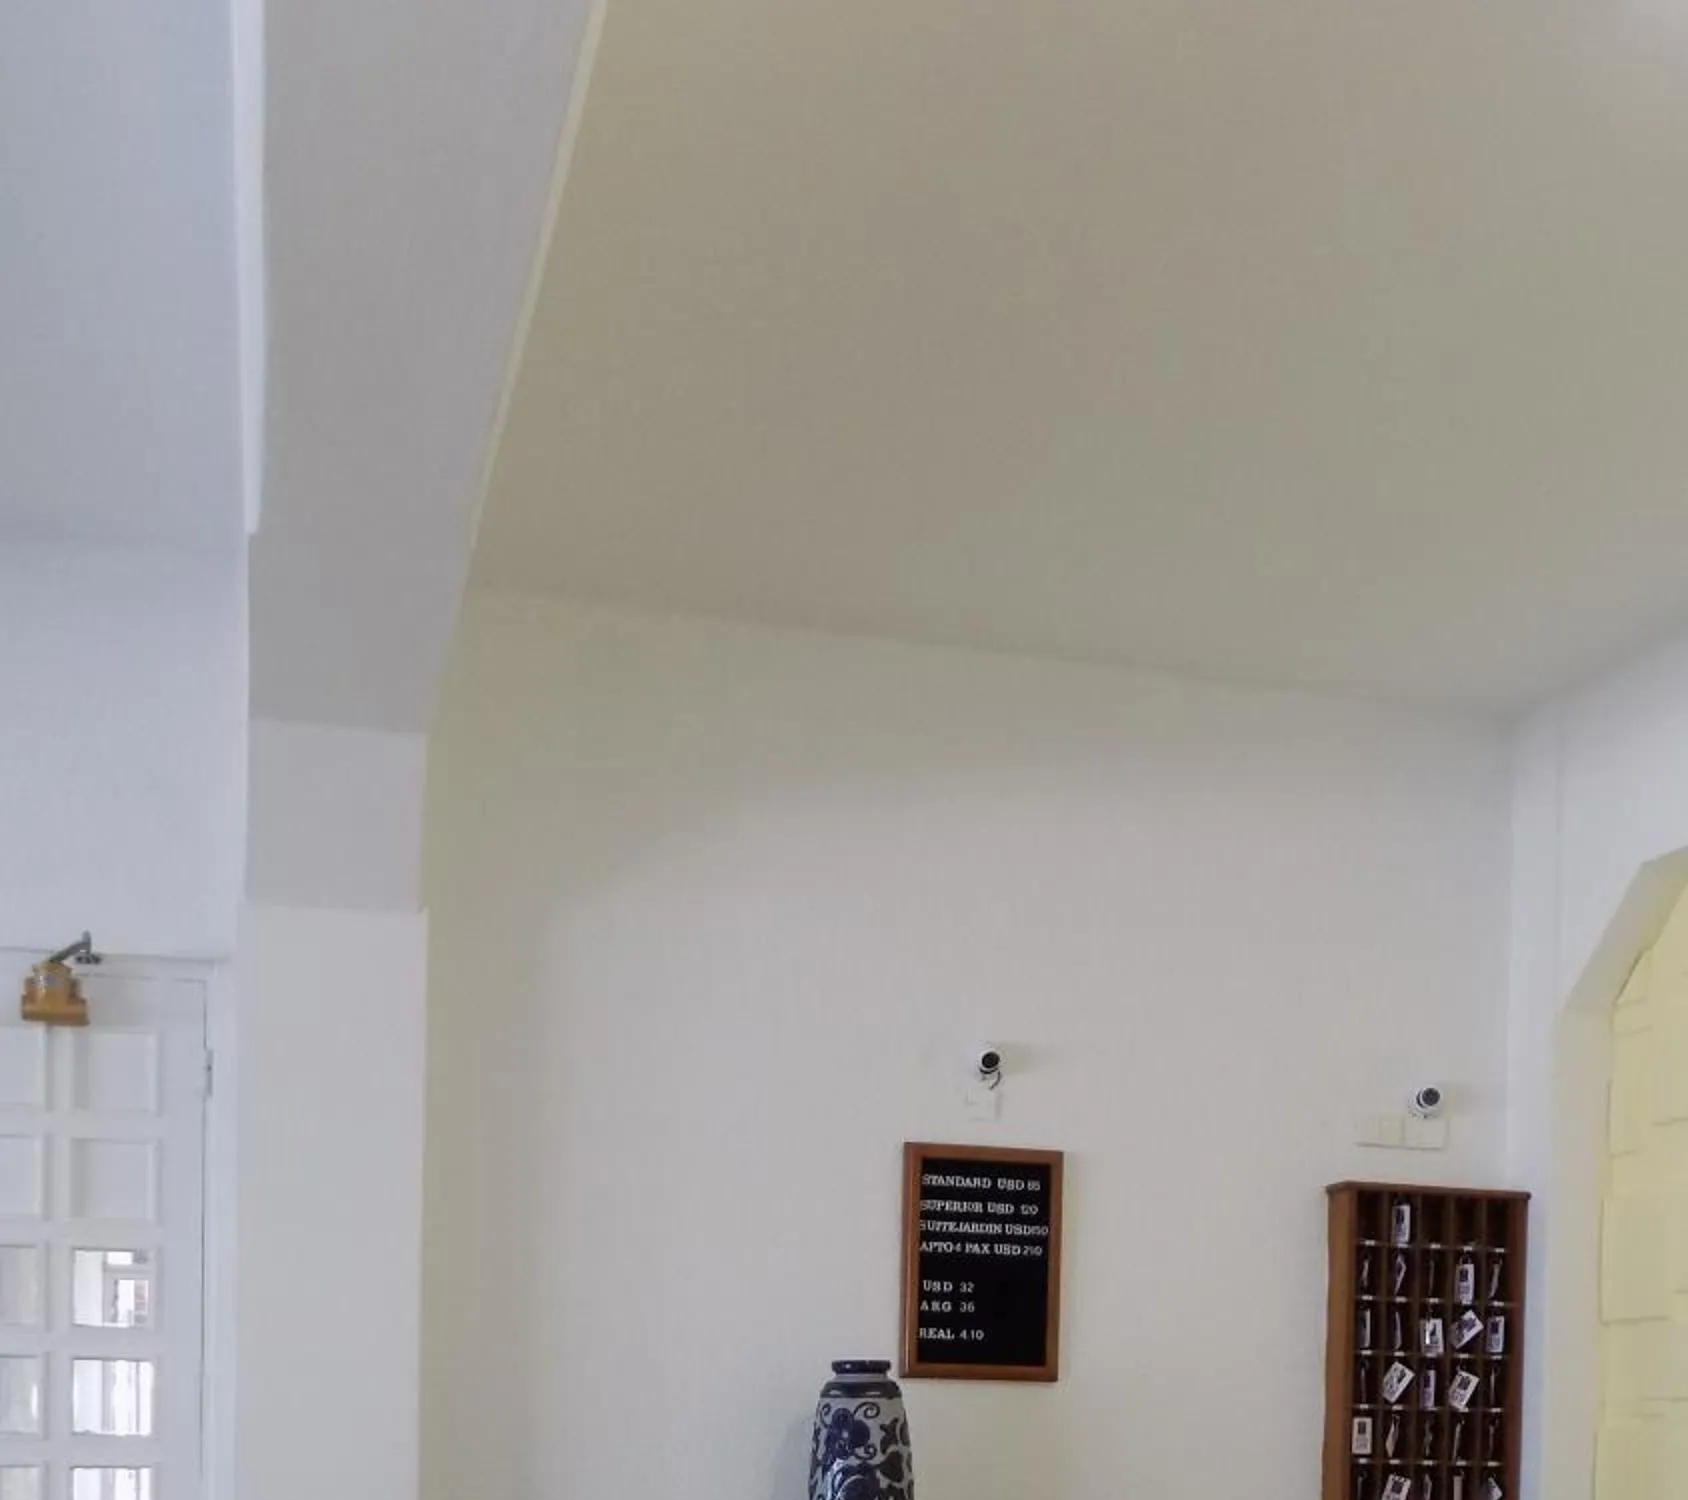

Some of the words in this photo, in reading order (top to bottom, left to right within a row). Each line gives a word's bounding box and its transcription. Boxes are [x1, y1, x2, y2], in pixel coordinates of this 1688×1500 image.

[922, 1174, 992, 1189] STANDARD
[921, 1200, 983, 1213] SUPERIOR
[919, 1328, 955, 1340] REAL
